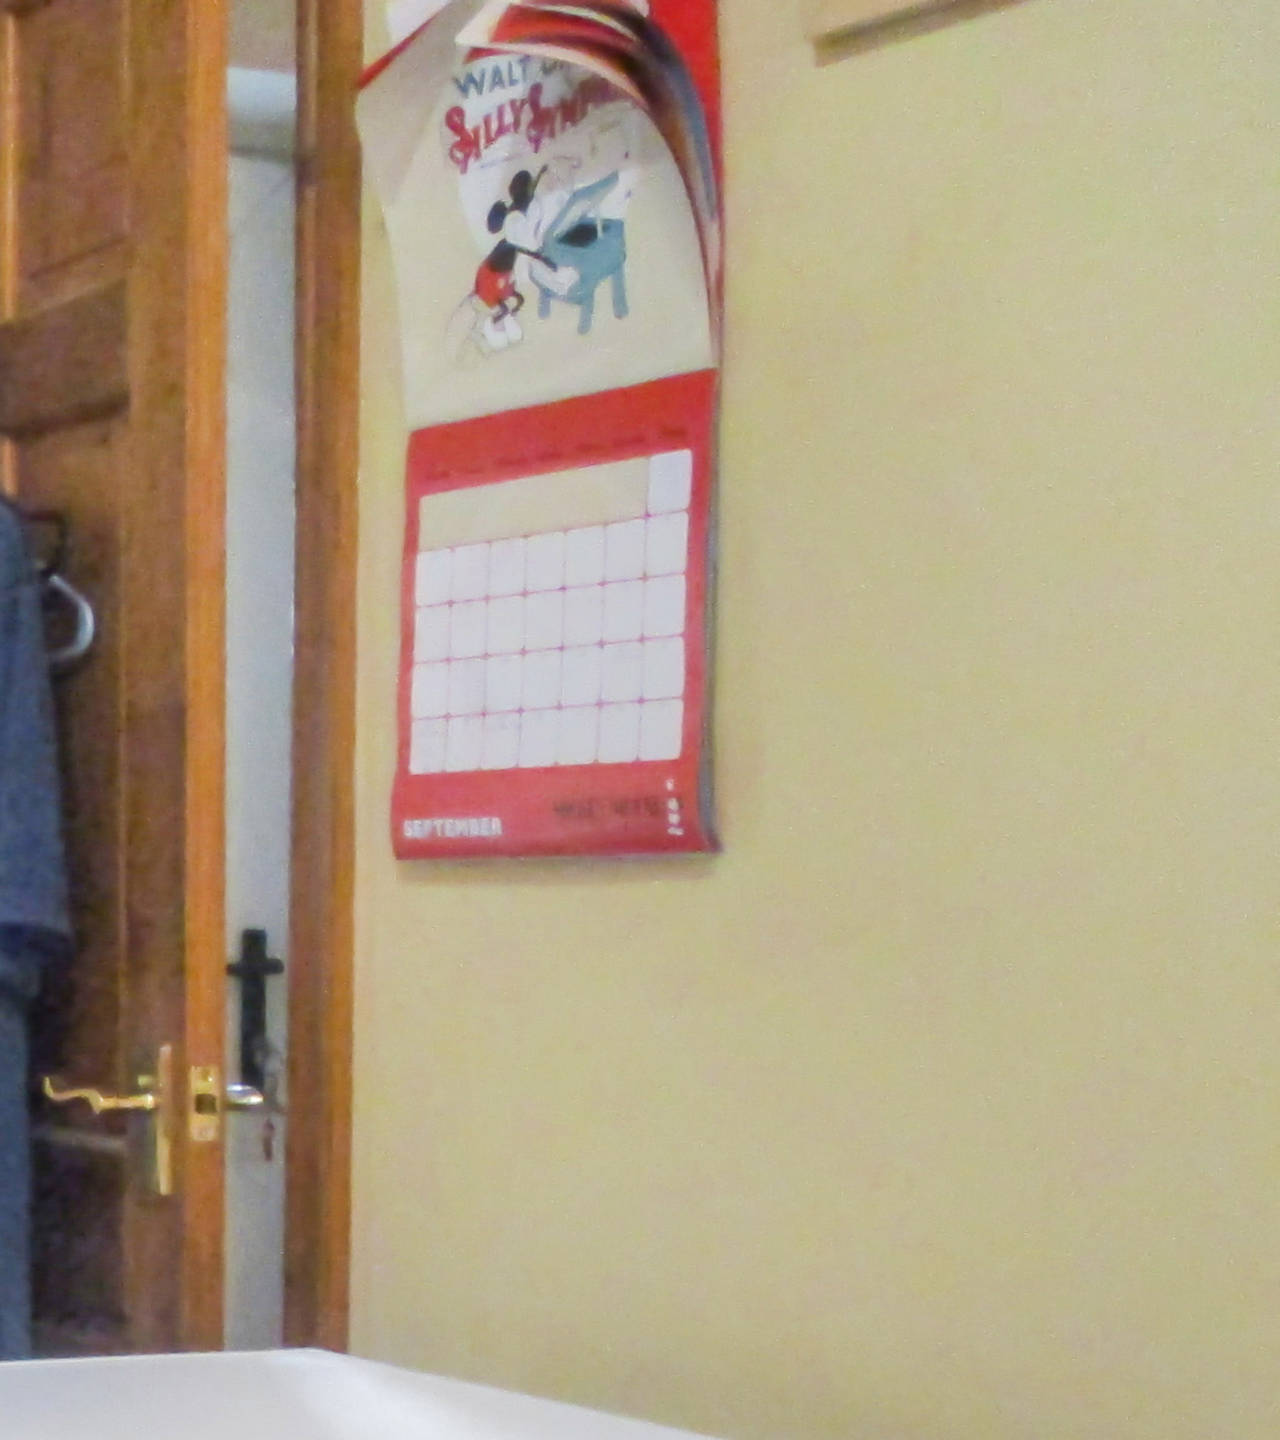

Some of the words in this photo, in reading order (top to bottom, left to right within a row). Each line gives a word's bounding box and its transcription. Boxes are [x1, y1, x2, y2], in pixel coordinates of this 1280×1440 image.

[453, 55, 532, 97] WALT
[445, 98, 528, 174] SILLY
[403, 817, 502, 838] SEPTEMBER
